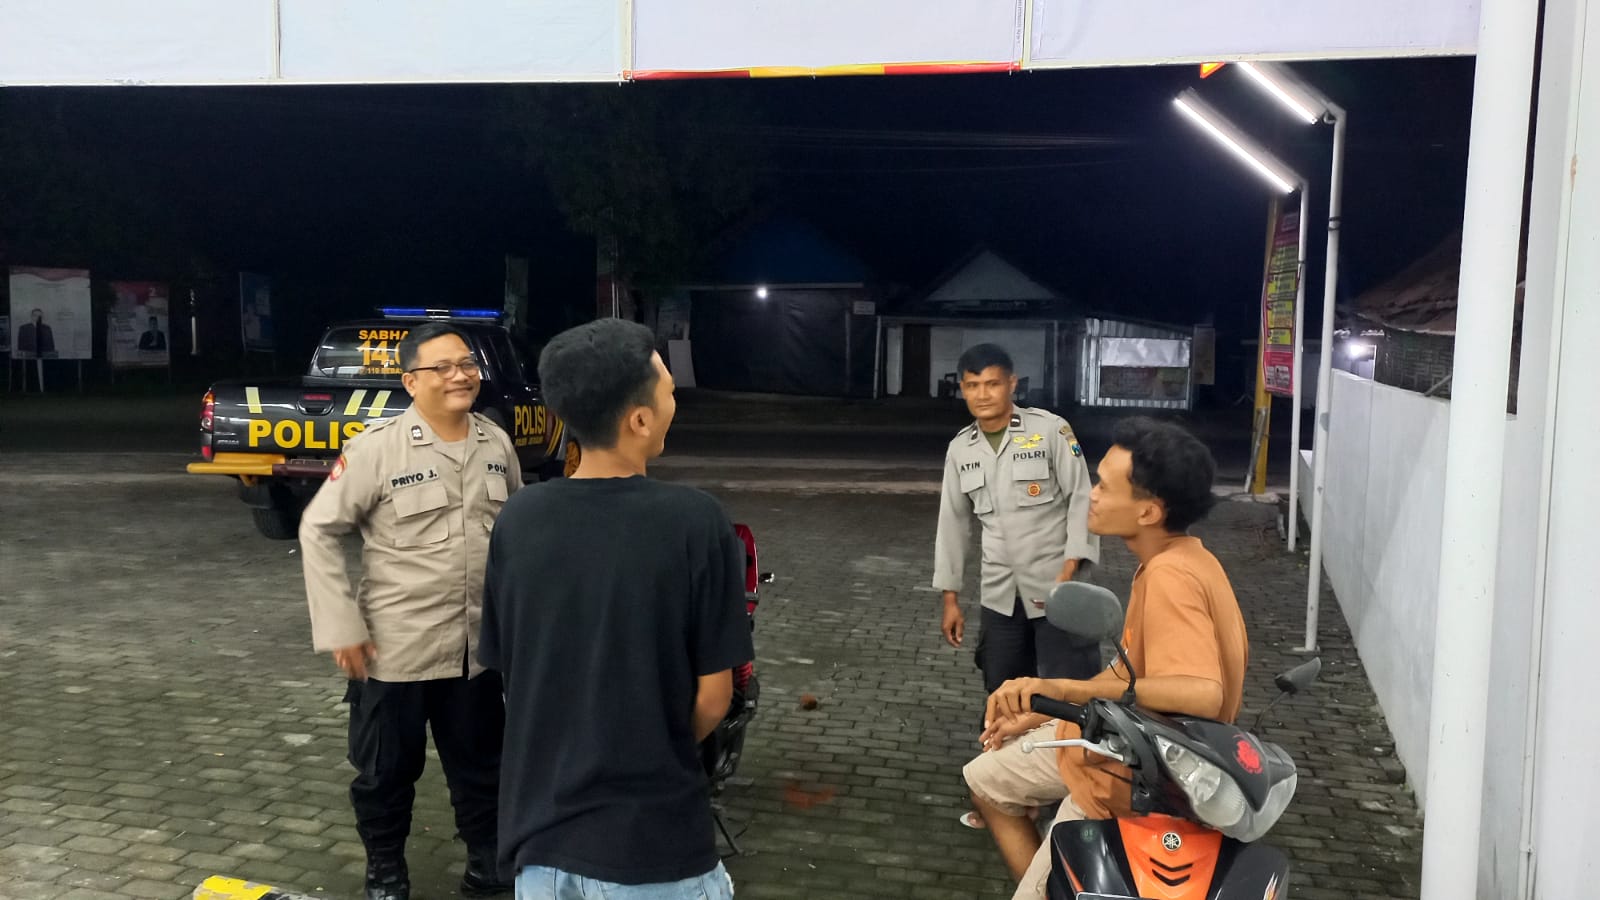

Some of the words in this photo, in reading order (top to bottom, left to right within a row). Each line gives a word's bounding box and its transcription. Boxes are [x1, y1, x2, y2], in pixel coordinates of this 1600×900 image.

[514, 405, 546, 437] POLISI
[1013, 450, 1046, 462] POLRI
[960, 461, 981, 473] ATIN
[391, 472, 424, 488] PRIYO
[428, 469, 438, 479] J.
